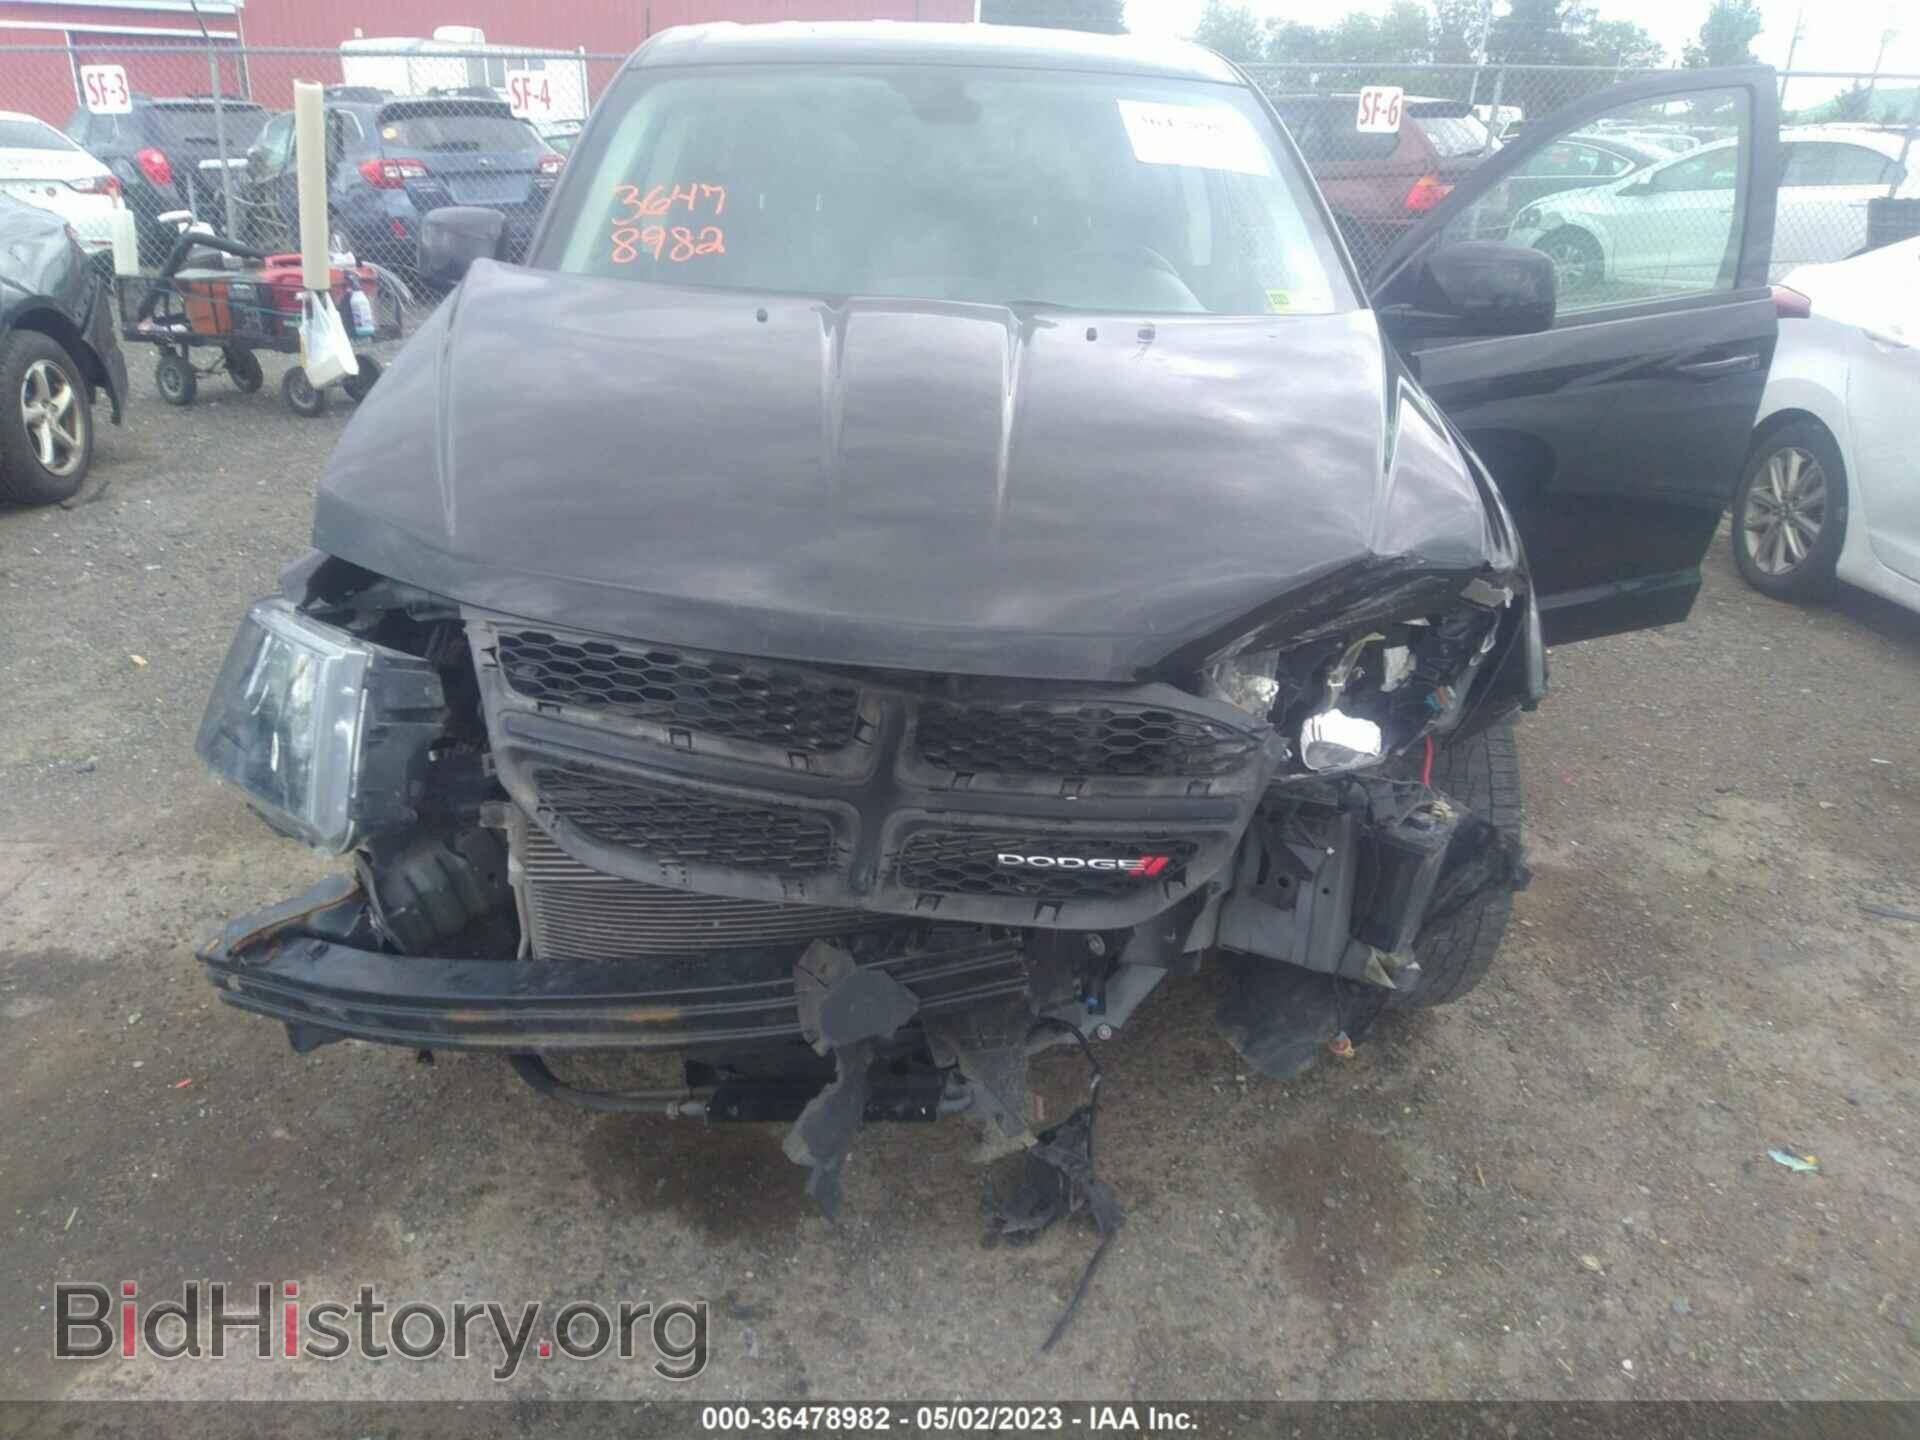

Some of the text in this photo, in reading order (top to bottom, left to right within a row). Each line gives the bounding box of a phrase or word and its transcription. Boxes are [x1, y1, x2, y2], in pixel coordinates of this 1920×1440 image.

[87, 73, 128, 105] SF-3
[511, 77, 551, 110] SF-4
[1360, 92, 1399, 126] SF-6
[611, 183, 725, 225] 3647
[611, 225, 725, 262] 8982
[997, 854, 1145, 871] DODGE
